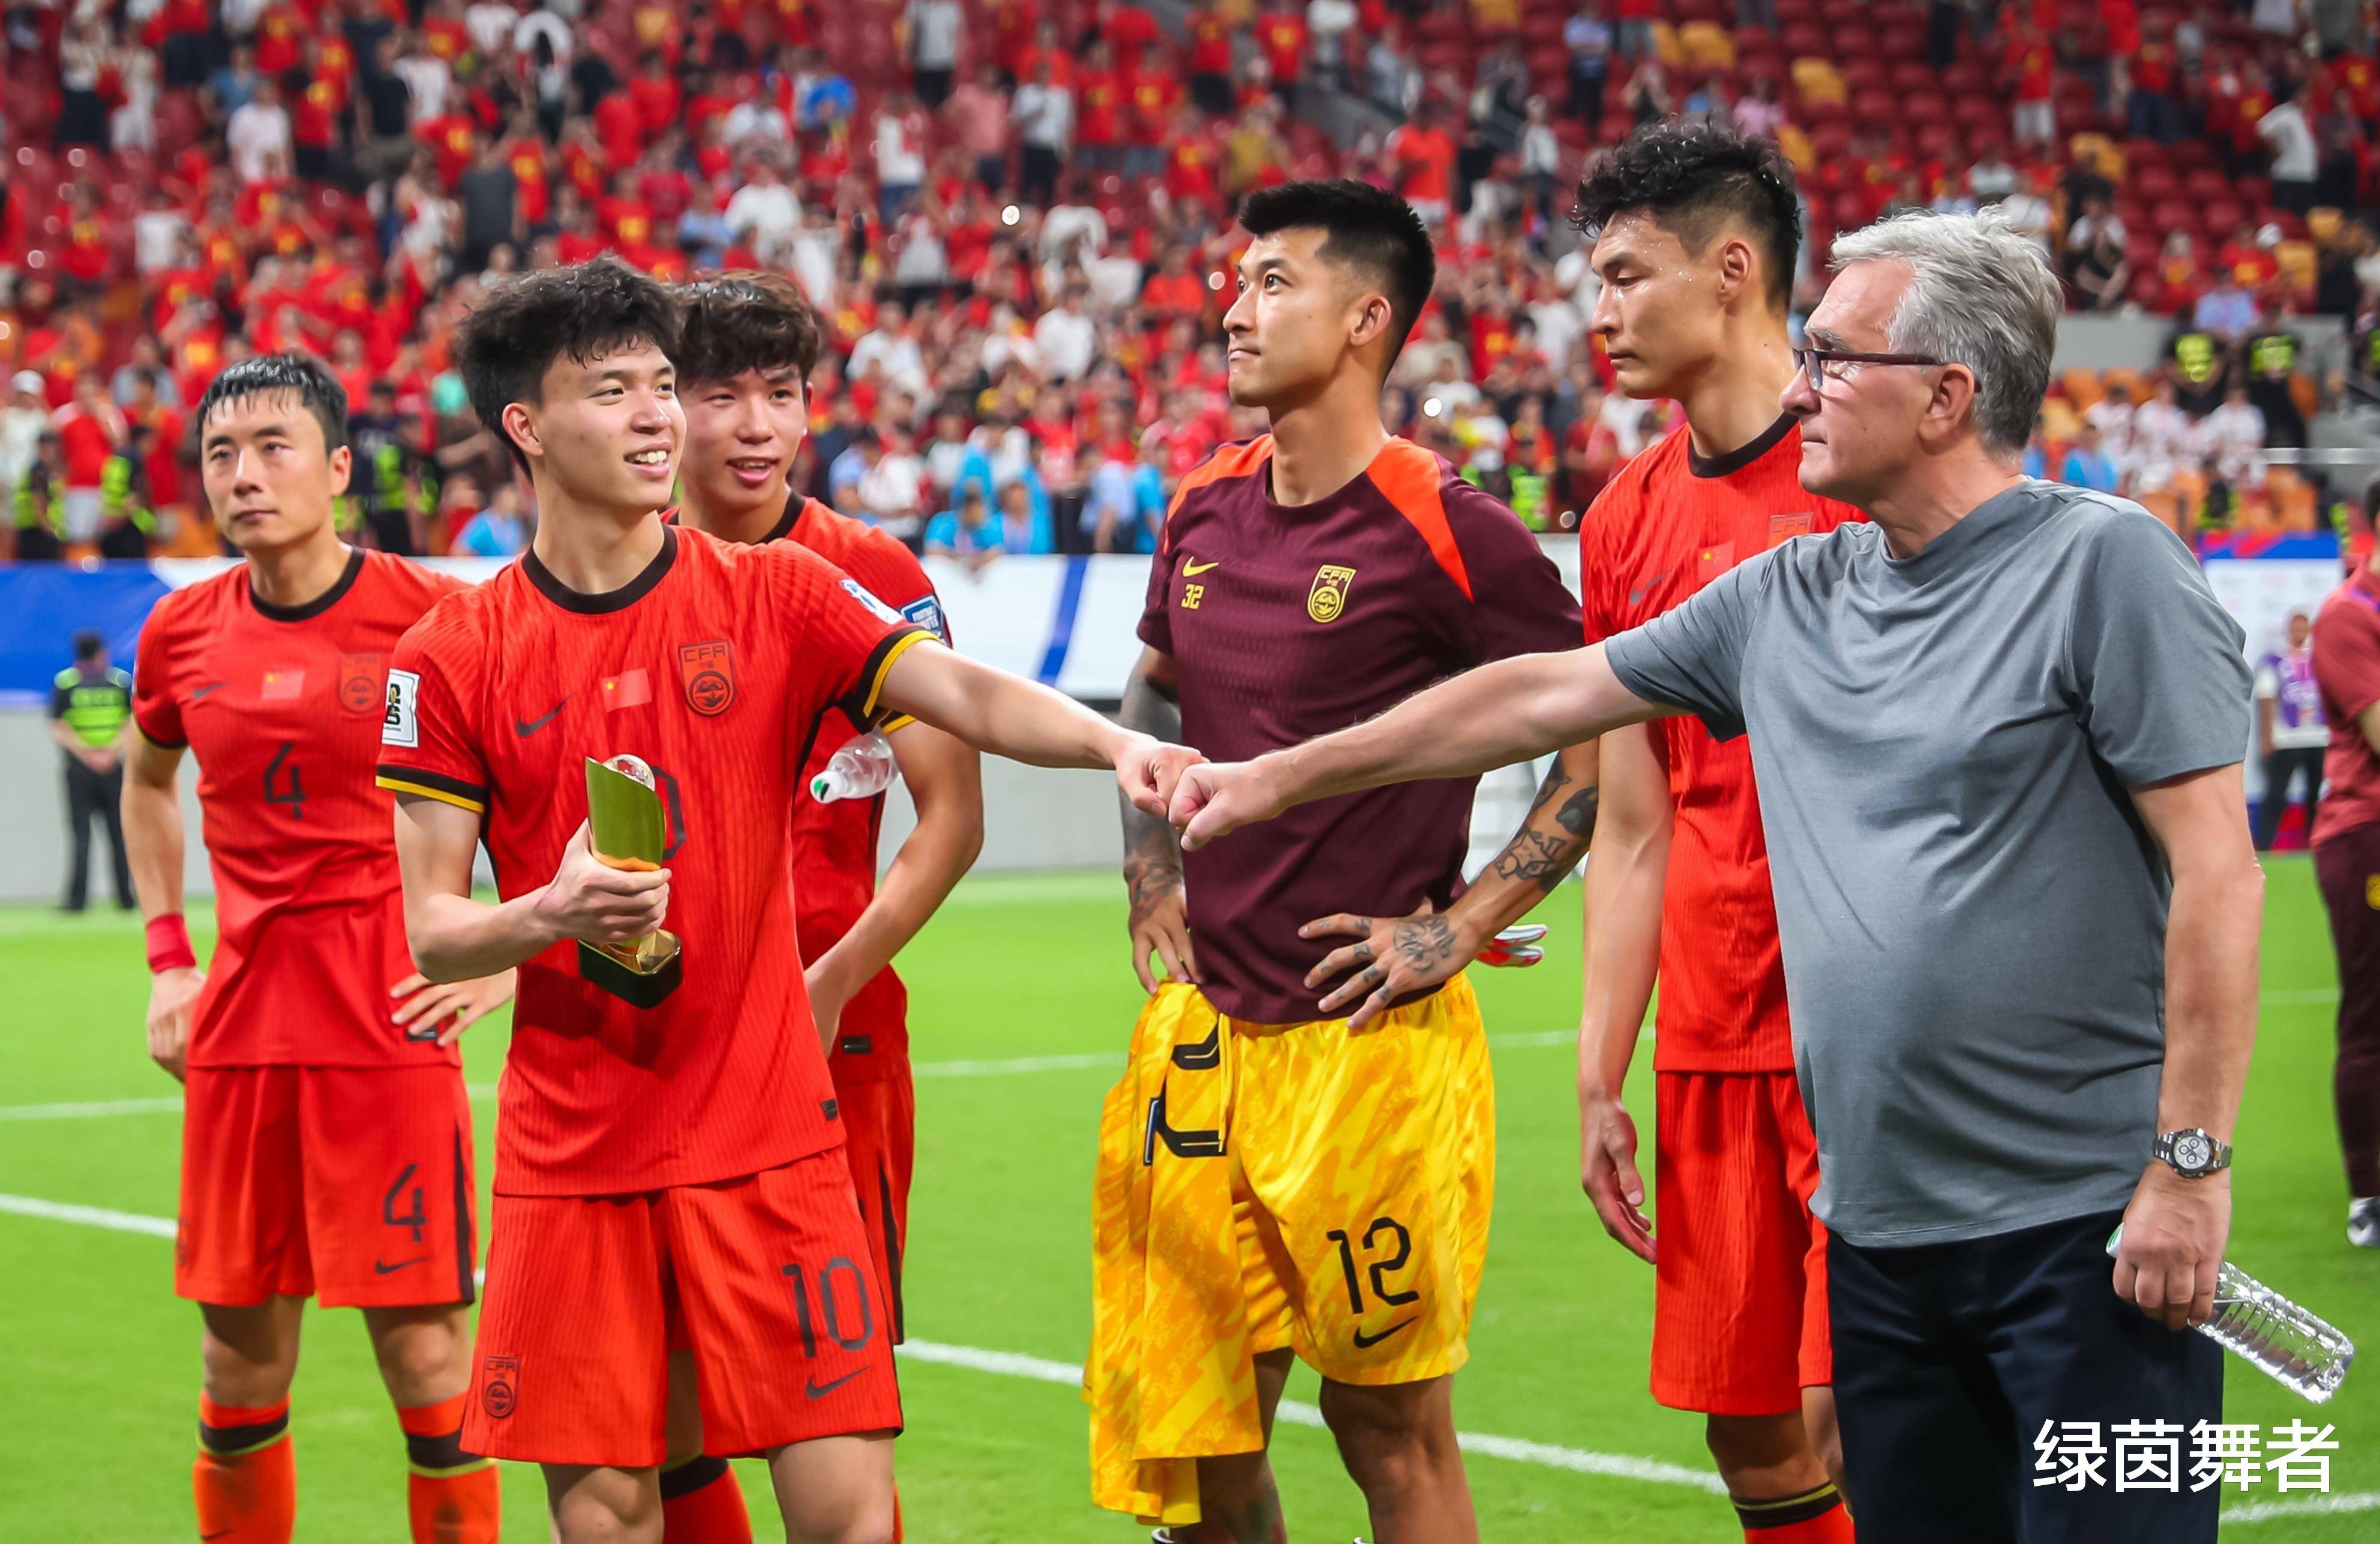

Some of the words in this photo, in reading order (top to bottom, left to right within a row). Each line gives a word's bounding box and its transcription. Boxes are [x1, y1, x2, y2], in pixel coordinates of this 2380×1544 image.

[1181, 584, 1204, 609] 32
[1320, 569, 1350, 582] CFA
[684, 645, 725, 662] CFA
[265, 742, 307, 820] 4
[385, 1163, 427, 1242] 4
[1326, 1217, 1419, 1314] 12
[782, 1256, 874, 1359] 10
[486, 1360, 515, 1371] CFA
